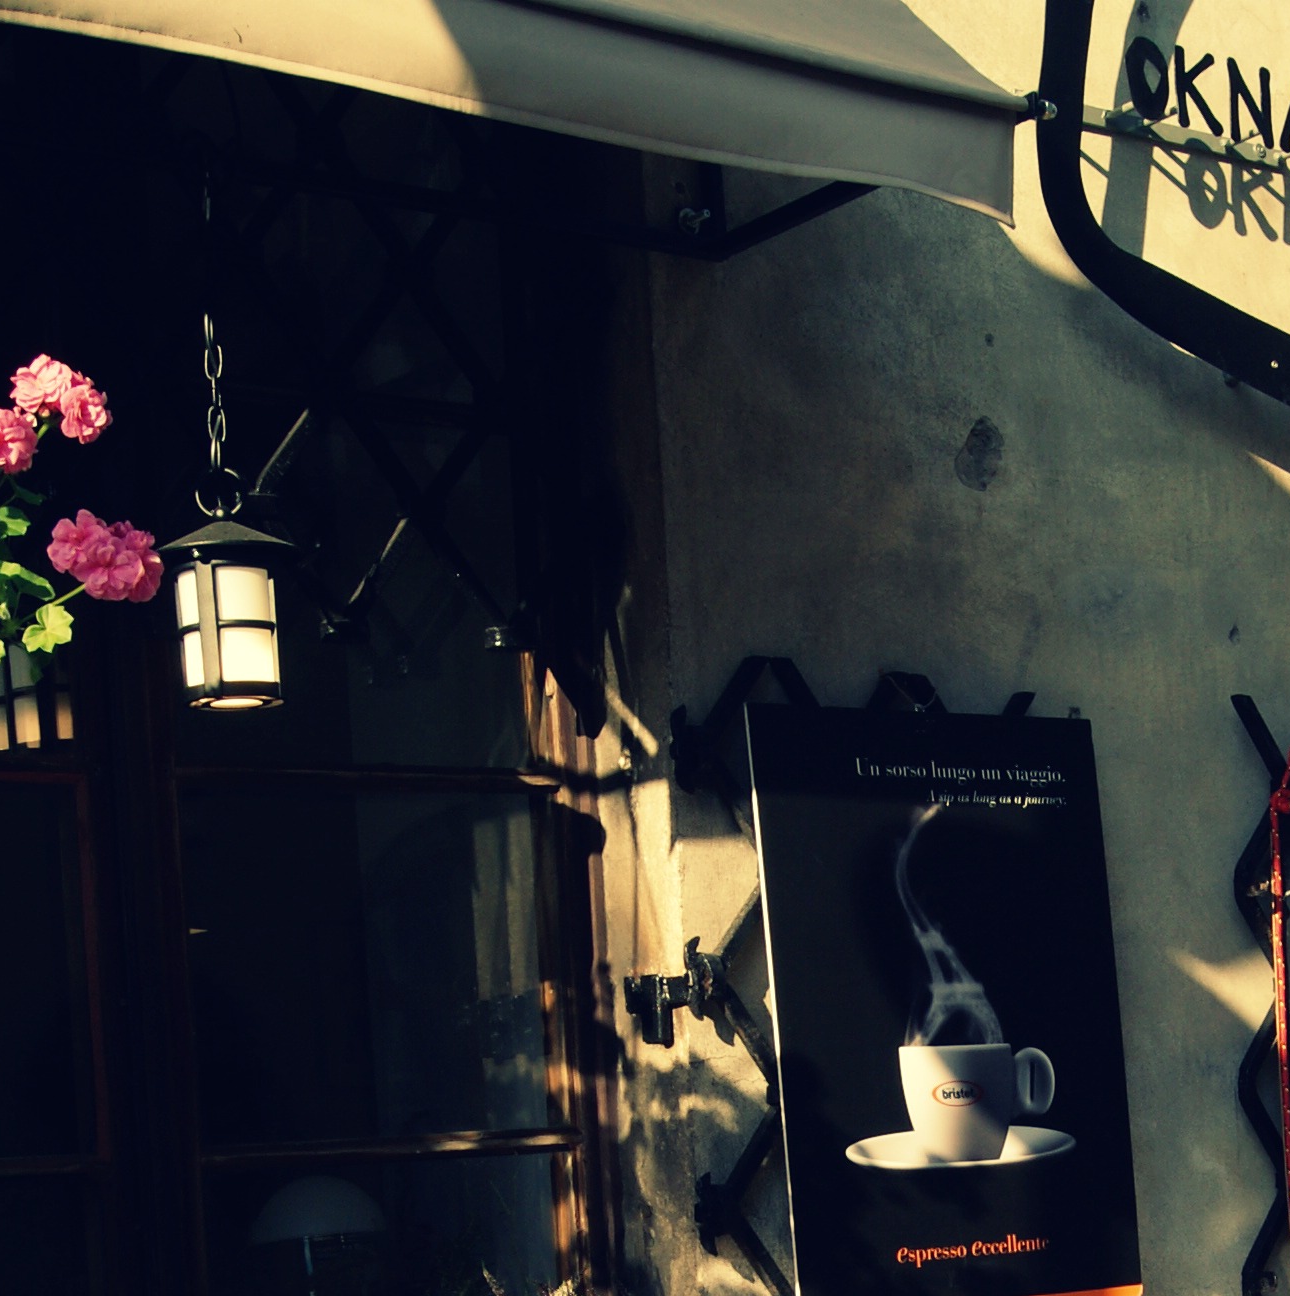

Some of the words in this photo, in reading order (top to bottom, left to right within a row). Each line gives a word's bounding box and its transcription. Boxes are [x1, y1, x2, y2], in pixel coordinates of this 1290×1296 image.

[856, 757, 880, 777] Un
[885, 764, 927, 778] sorso
[930, 759, 976, 786] lungo
[981, 768, 1001, 781] un
[1006, 763, 1066, 788] viaggio.
[972, 789, 997, 808] long
[999, 793, 1012, 805] as
[1013, 794, 1022, 805] a
[897, 1246, 967, 1269] espresso
[971, 1233, 1050, 1257] eccellente
